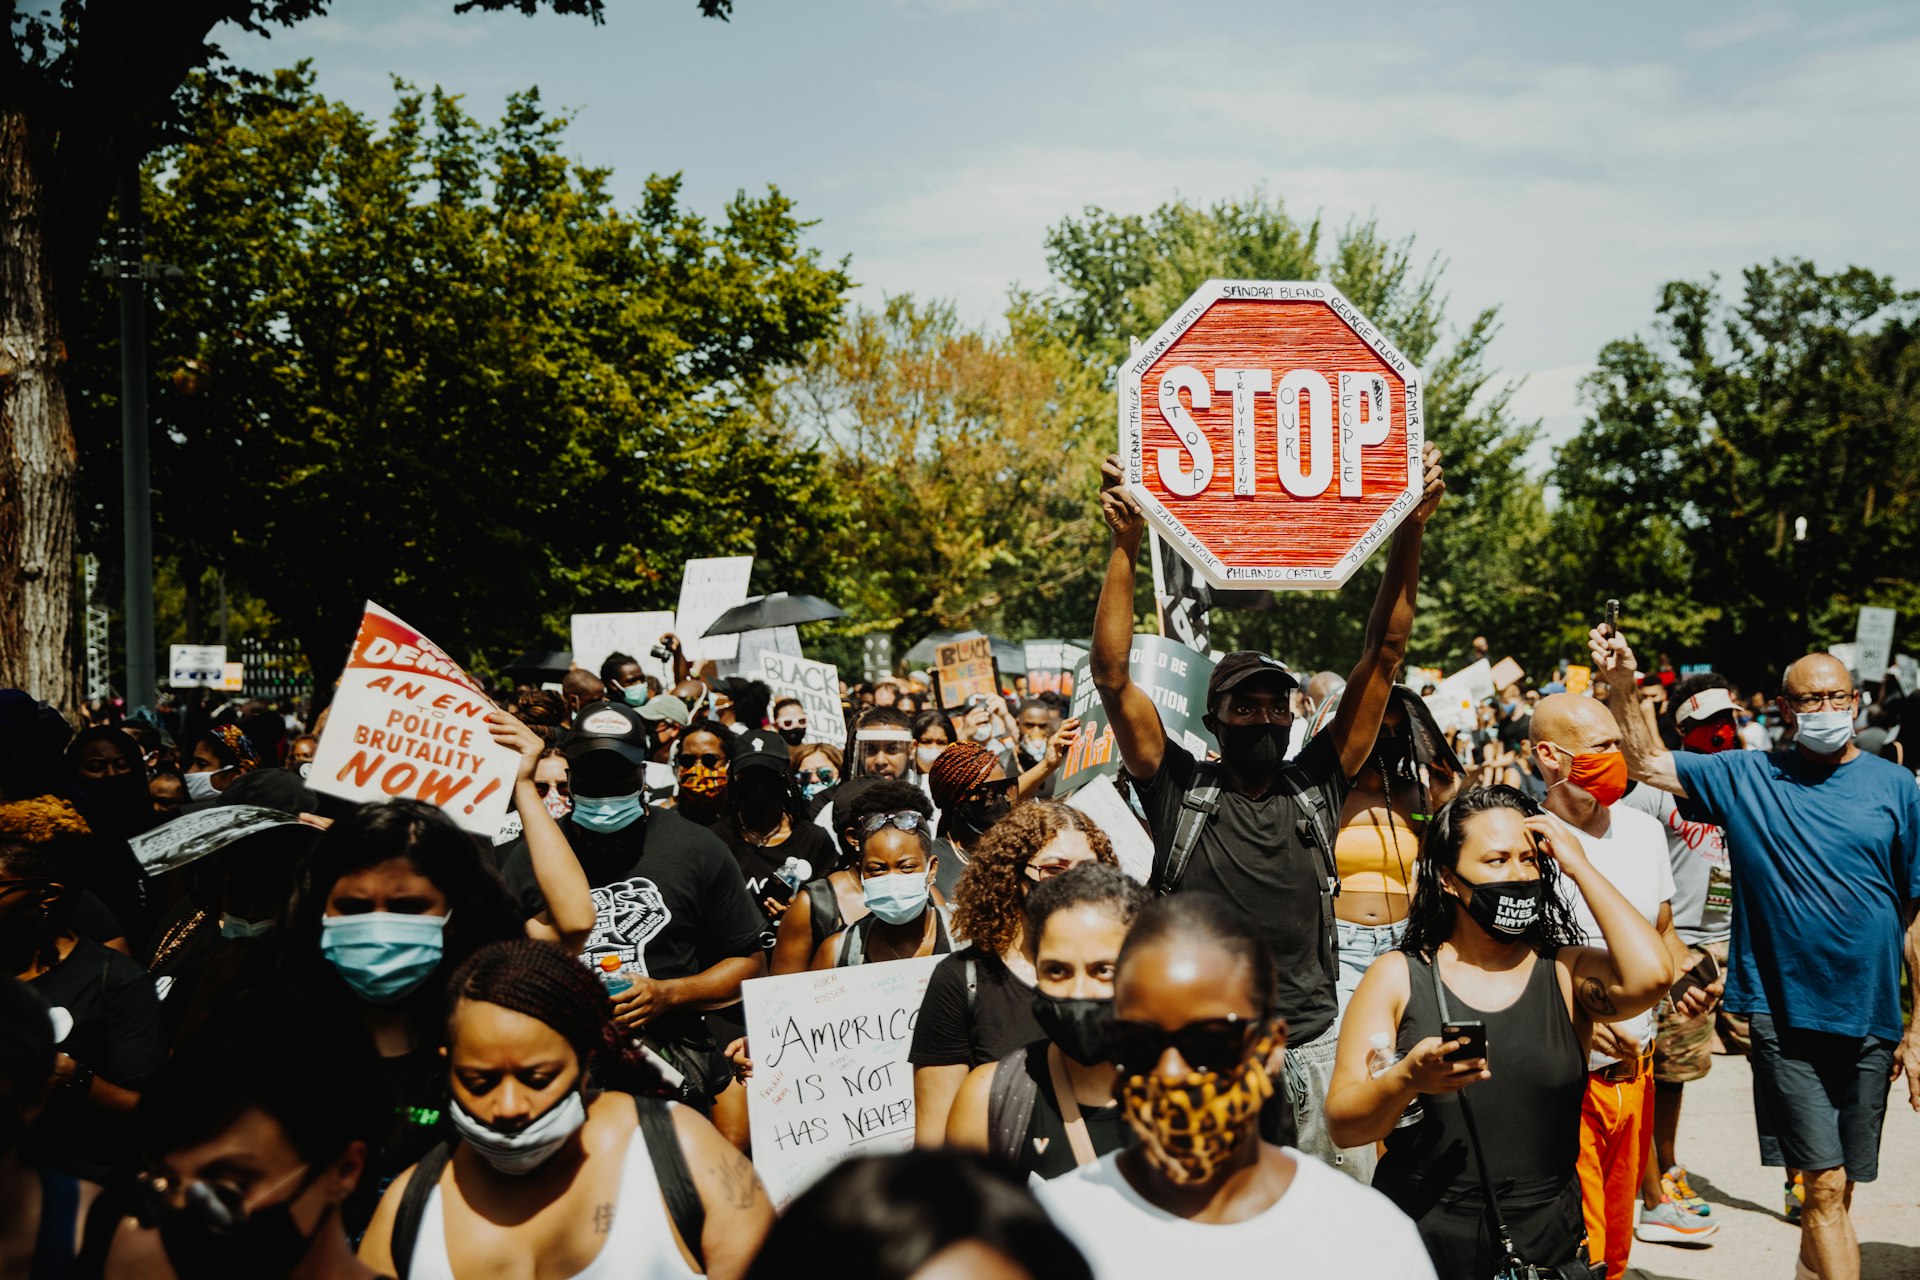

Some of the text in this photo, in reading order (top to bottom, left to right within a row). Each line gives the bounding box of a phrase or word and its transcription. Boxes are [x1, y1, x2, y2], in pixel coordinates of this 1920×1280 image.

[1280, 287, 1325, 298] BLAND
[1131, 302, 1205, 376] TRAYVON MARTIN
[1330, 297, 1405, 372] GEORGE FLOYD
[1129, 386, 1142, 484] BREONNA TAYLOR
[1157, 365, 1391, 497] STOP
[1405, 379, 1419, 467] TAMIR RICE
[1153, 504, 1220, 568] JACOB BLAKE
[1345, 490, 1415, 563] ERIC GARNER
[1226, 567, 1333, 579] PHILANDO CASTILE
[764, 657, 840, 696] BLACK
[1170, 656, 1188, 678] BE
[366, 674, 497, 724] AN EN
[416, 705, 445, 719] TO
[354, 724, 486, 775] BRUTALITY
[386, 708, 474, 749] POLICE
[336, 750, 502, 815] NOW!
[643, 911, 659, 923] LIKE
[1497, 905, 1533, 918] LIVES
[1499, 895, 1536, 909] BLACK
[630, 913, 666, 943] FREDERICK
[796, 1061, 896, 1104] IS NOT
[774, 1098, 916, 1150] HAS NEVER
